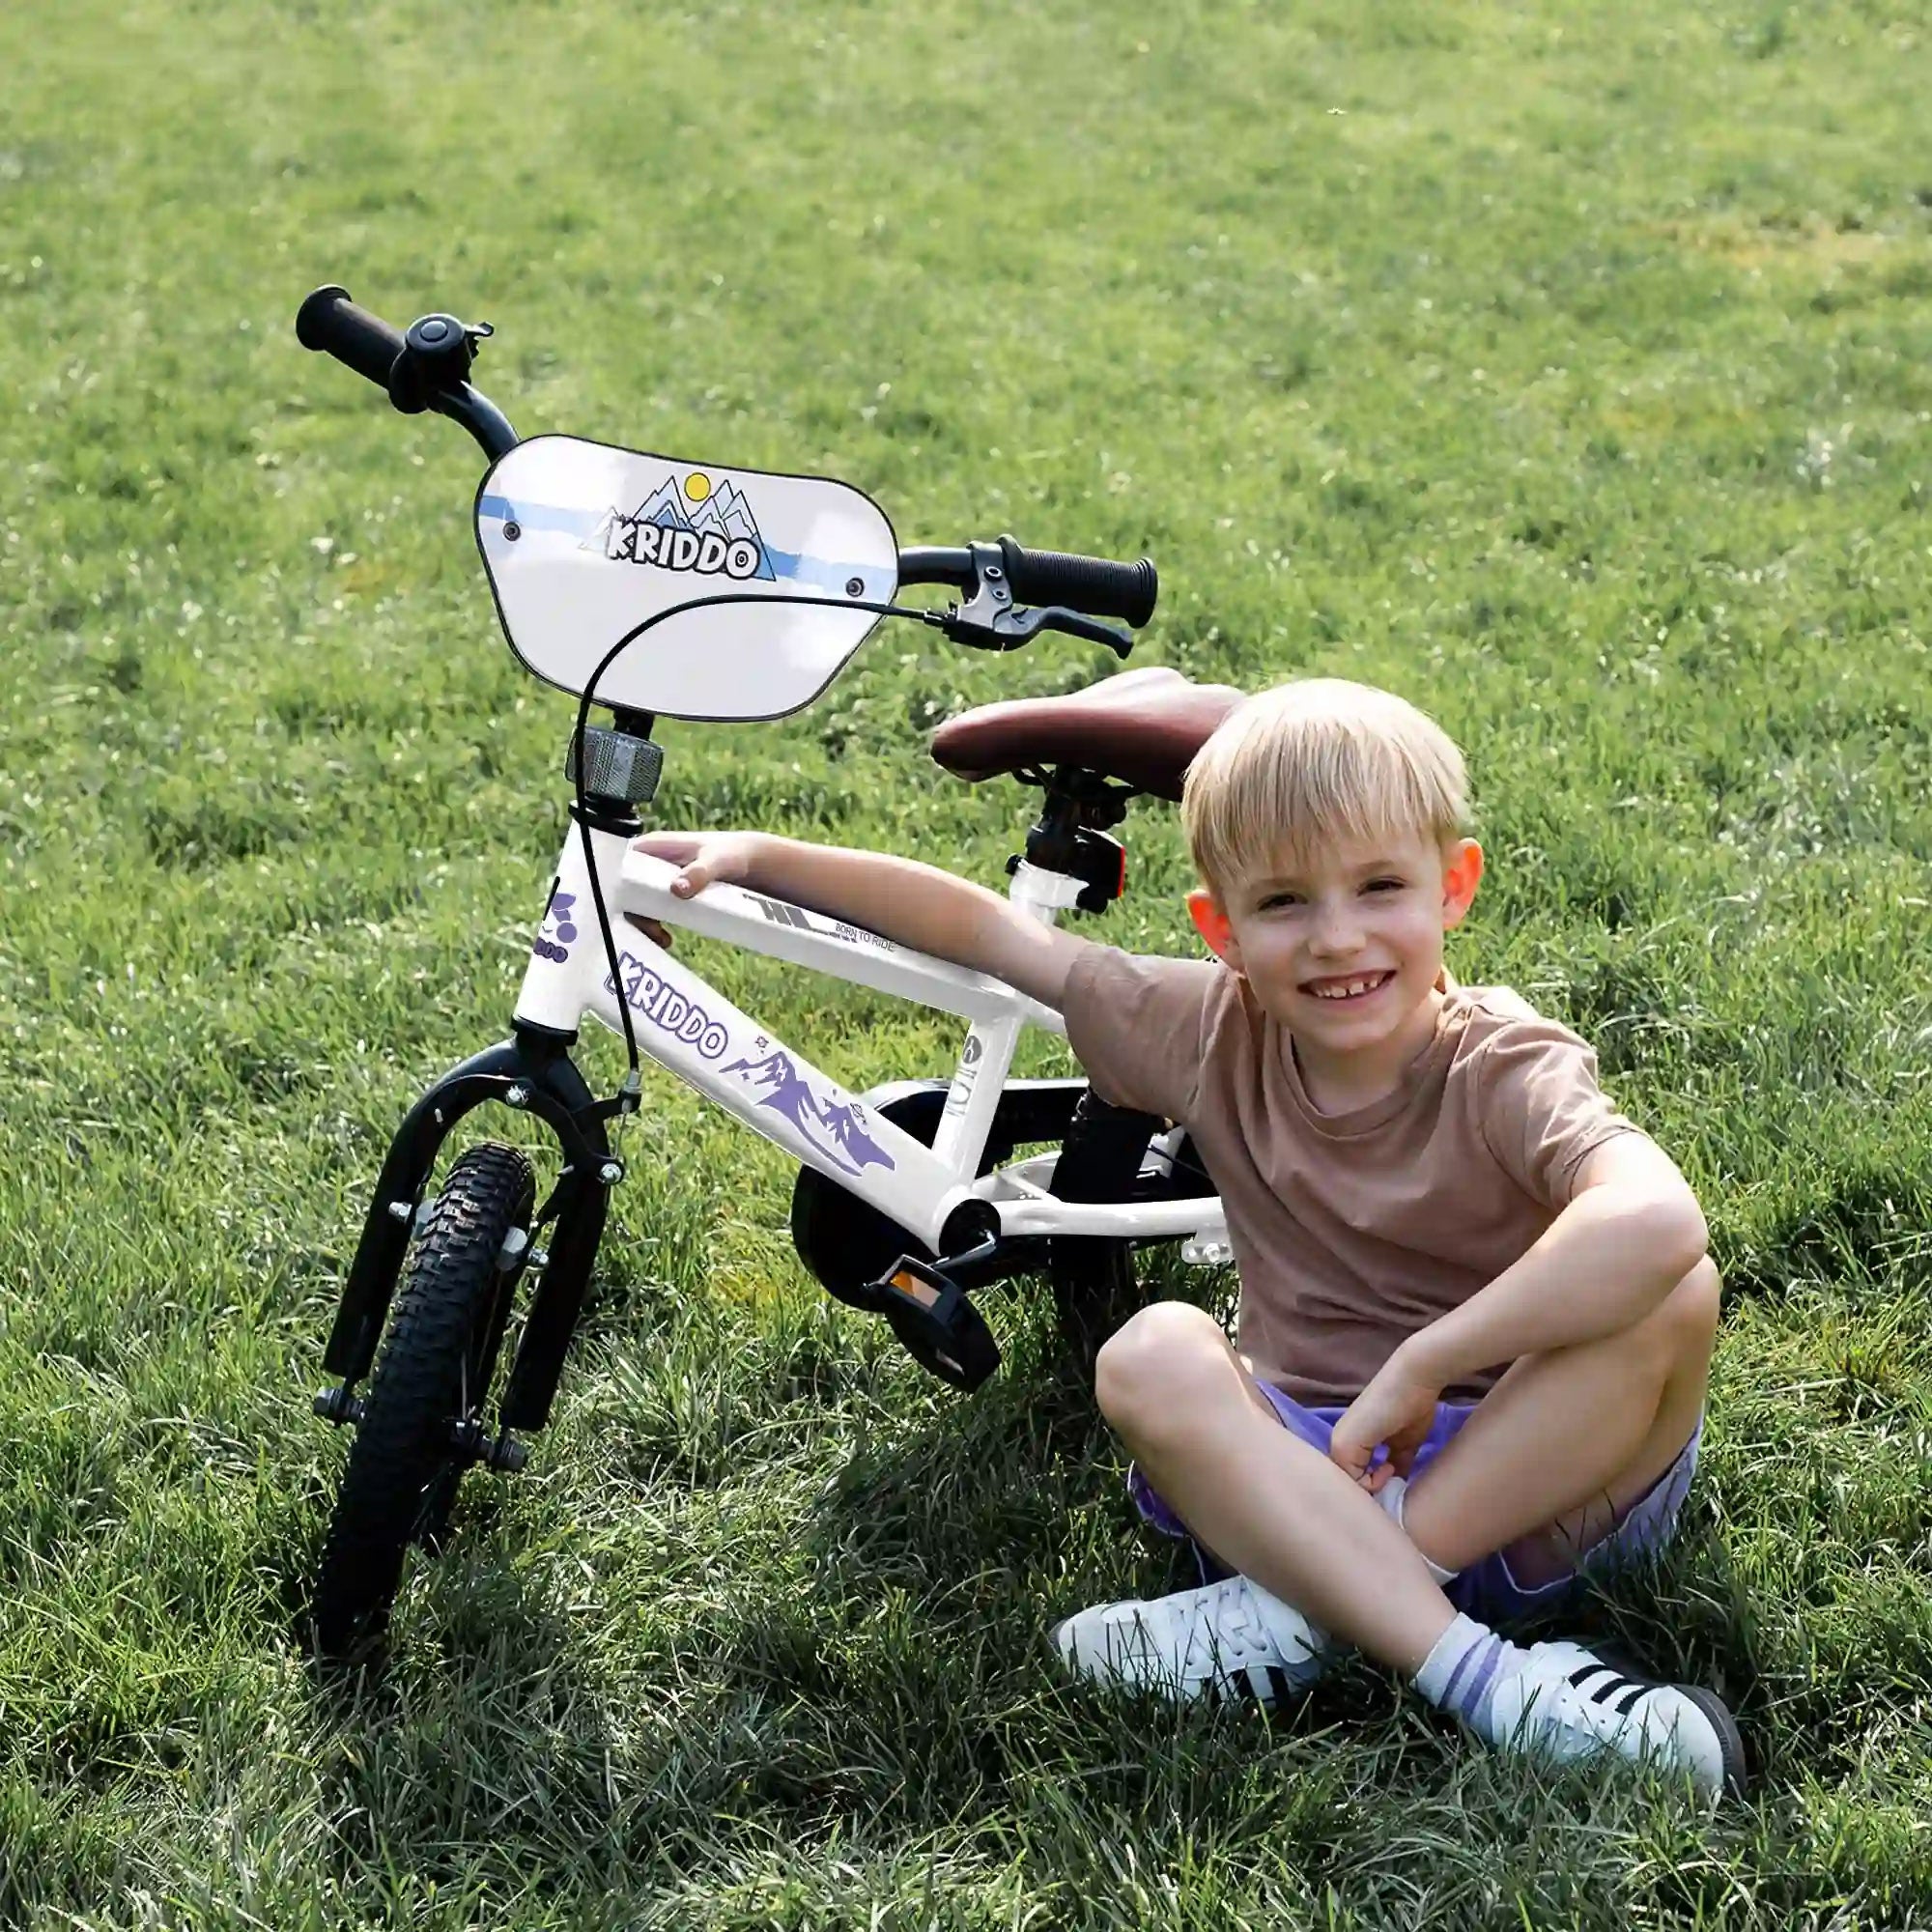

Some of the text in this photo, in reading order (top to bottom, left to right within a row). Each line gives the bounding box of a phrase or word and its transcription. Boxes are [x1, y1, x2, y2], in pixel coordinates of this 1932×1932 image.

[607, 516, 760, 580] KRIDDO
[836, 923, 896, 952] BORN TO RIDE
[604, 951, 728, 1059] KRIDDO
